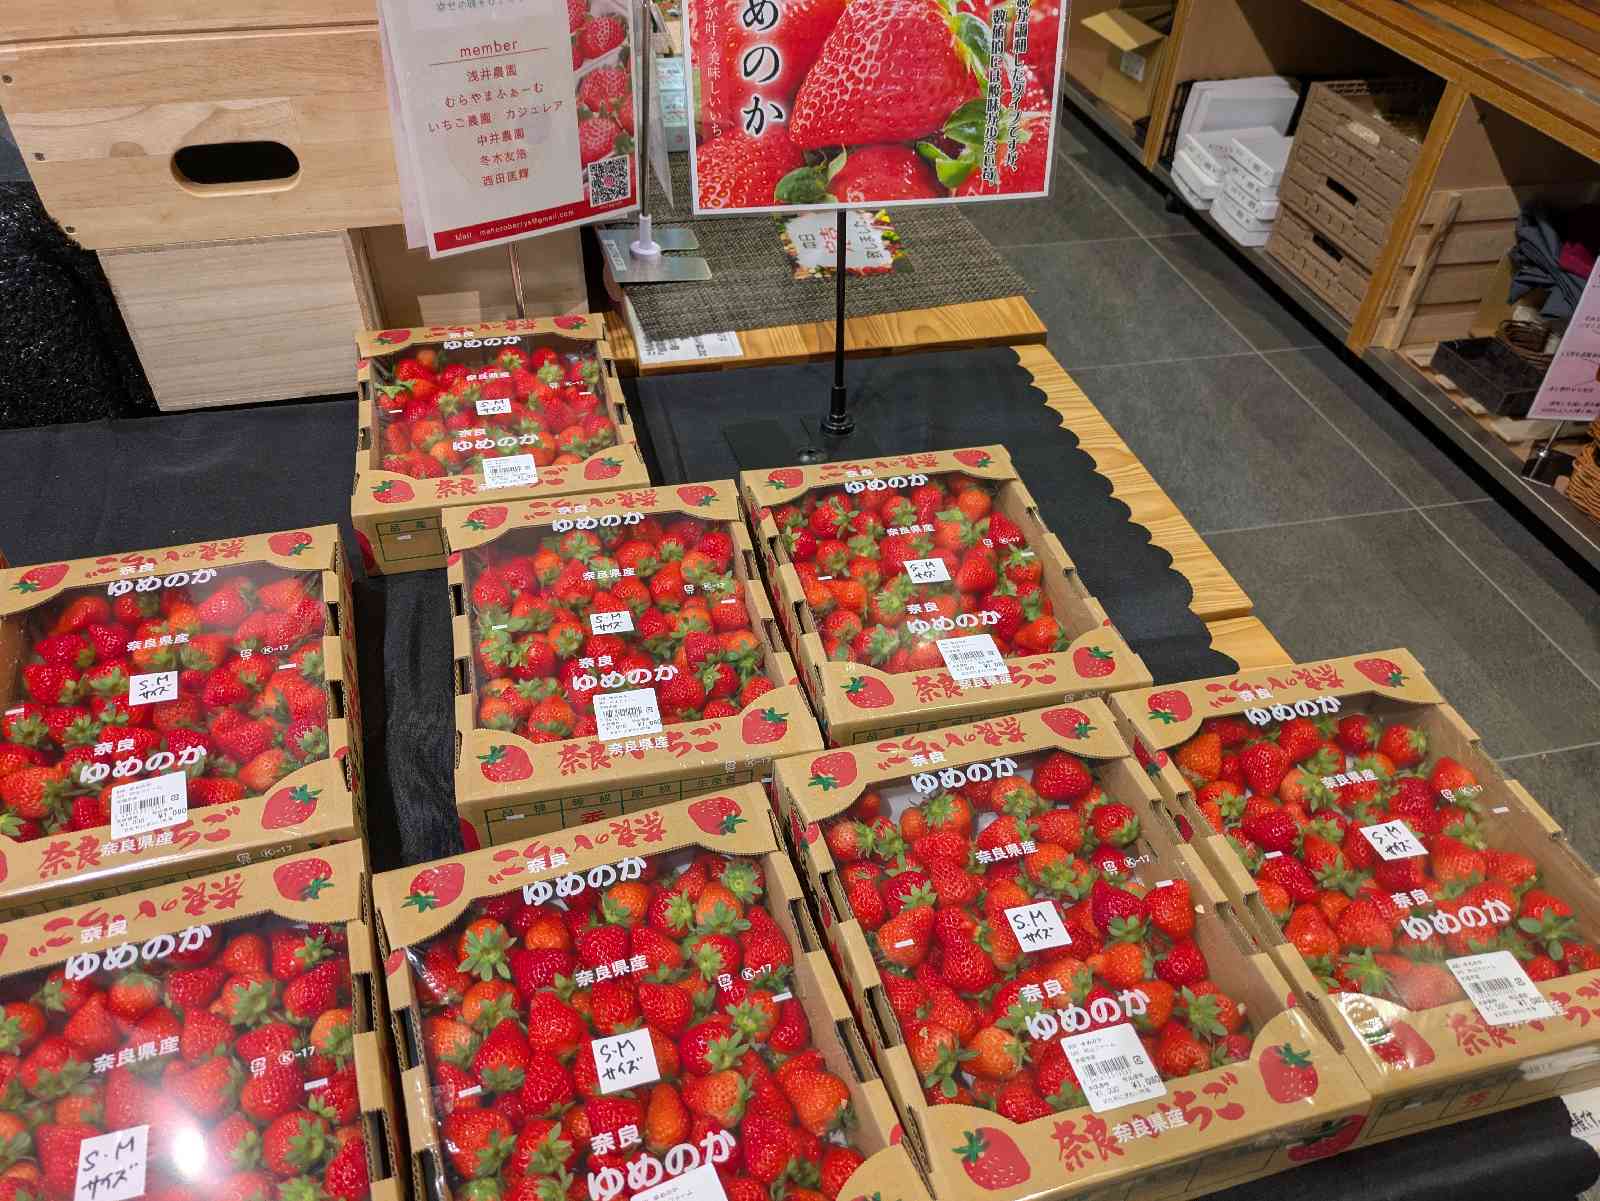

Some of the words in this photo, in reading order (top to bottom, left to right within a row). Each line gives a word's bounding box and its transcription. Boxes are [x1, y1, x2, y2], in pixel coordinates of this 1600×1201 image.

[459, 40, 520, 58] member
[466, 63, 518, 82] 浅井農園
[427, 111, 492, 133] いちご農園
[477, 127, 525, 147] 中井農園
[443, 335, 522, 350] ゆめのか
[452, 433, 540, 452] ゆめのか
[844, 473, 929, 495] ゆめのか
[845, 468, 874, 478] 奈良
[558, 504, 588, 515] 奈良
[551, 511, 646, 532] ゆめのか
[886, 523, 936, 536] 奈良県産
[119, 562, 155, 577] 奈良
[582, 567, 636, 581] 奈良県産
[107, 567, 218, 598] ゆめのか
[906, 601, 940, 614] 奈良
[906, 609, 1003, 635] ゆめのか
[126, 632, 191, 653] 奈良県産
[577, 654, 614, 670] 奈良
[571, 664, 679, 692] ゆめのか
[1238, 687, 1274, 702] 奈良
[1243, 695, 1342, 728] ゆめのか
[93, 737, 136, 756] 奈良
[79, 744, 209, 785] ゆめのか
[909, 750, 947, 768] 奈良
[908, 755, 1020, 798] ゆめのか
[1320, 769, 1379, 790] 奈良県産
[100, 830, 175, 857] 奈良県産
[974, 841, 1040, 866] 奈良県産
[526, 852, 569, 874] 奈良
[1124, 853, 1152, 870] K-17
[522, 855, 648, 907] ゆめのか
[1390, 889, 1433, 910] 奈良
[1400, 899, 1513, 941] ゆめのか
[79, 919, 129, 945] 奈良
[65, 924, 213, 982] ゆめのか
[575, 954, 650, 988] 奈良県産
[741, 963, 772, 981] K-17
[1019, 978, 1065, 1003] 奈良
[1024, 988, 1152, 1044] ゆめのか
[93, 1034, 181, 1074] 奈良県産
[278, 1045, 316, 1066] K-17
[602, 1054, 645, 1082] サイズ
[1111, 1107, 1189, 1144] 奈良県産
[589, 1123, 643, 1157] 奈良
[586, 1129, 738, 1201] ゆめのか
[81, 1162, 141, 1200] サイズ
